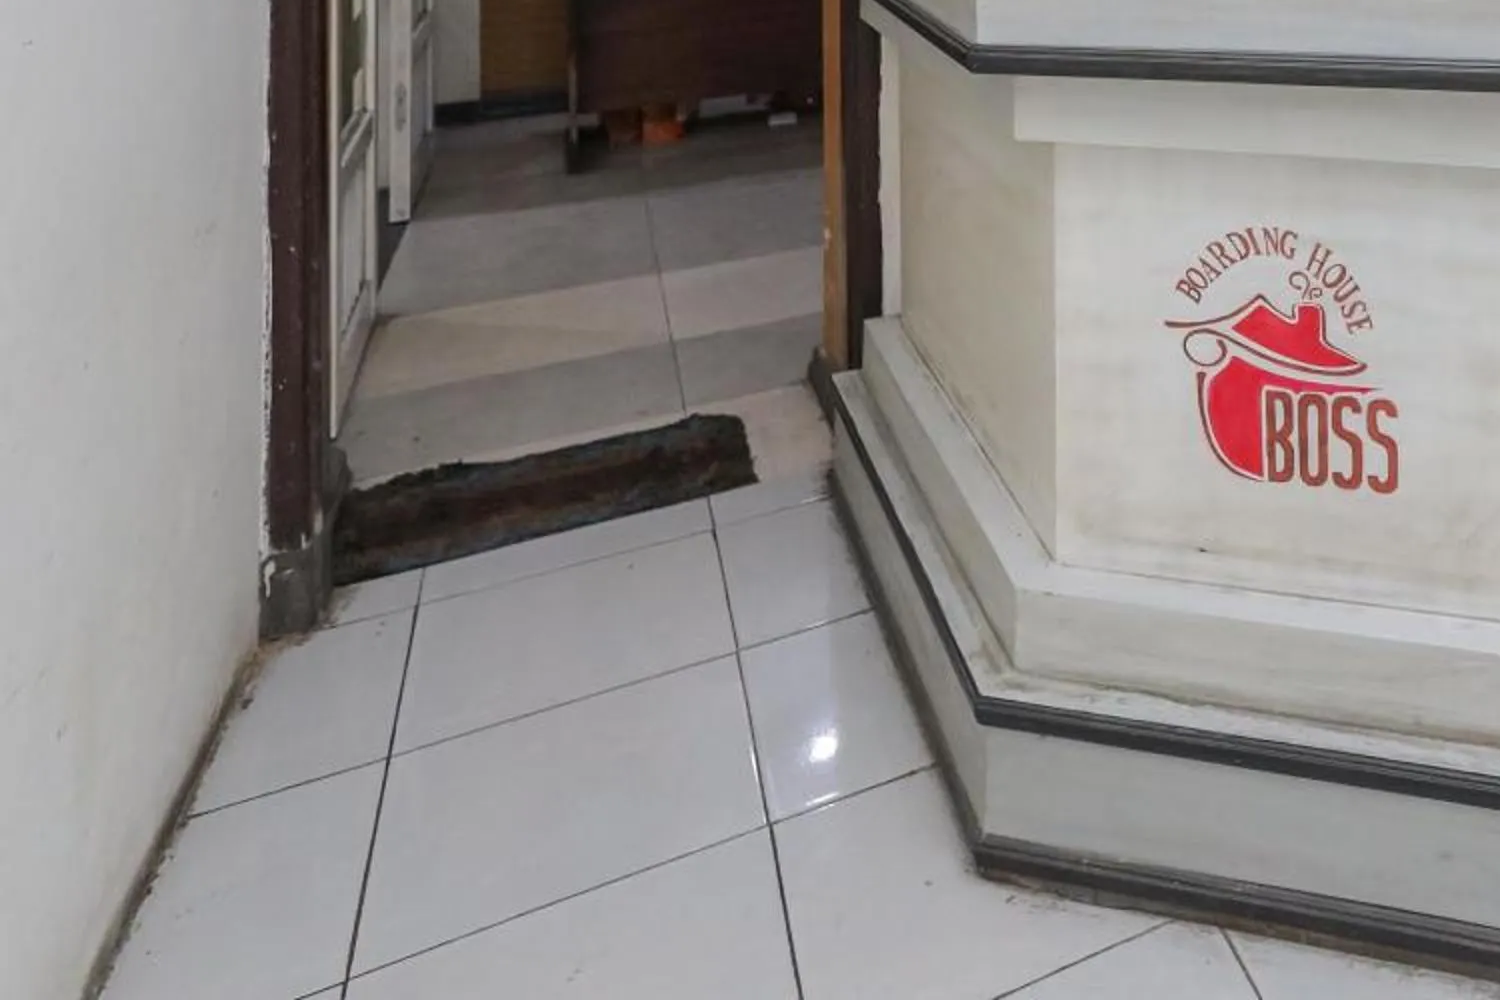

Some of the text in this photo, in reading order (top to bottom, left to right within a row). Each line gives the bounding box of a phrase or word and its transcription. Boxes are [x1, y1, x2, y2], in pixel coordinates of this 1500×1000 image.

[1175, 227, 1373, 335] BOARDING HOUSE
[1265, 389, 1399, 494] BOSS
